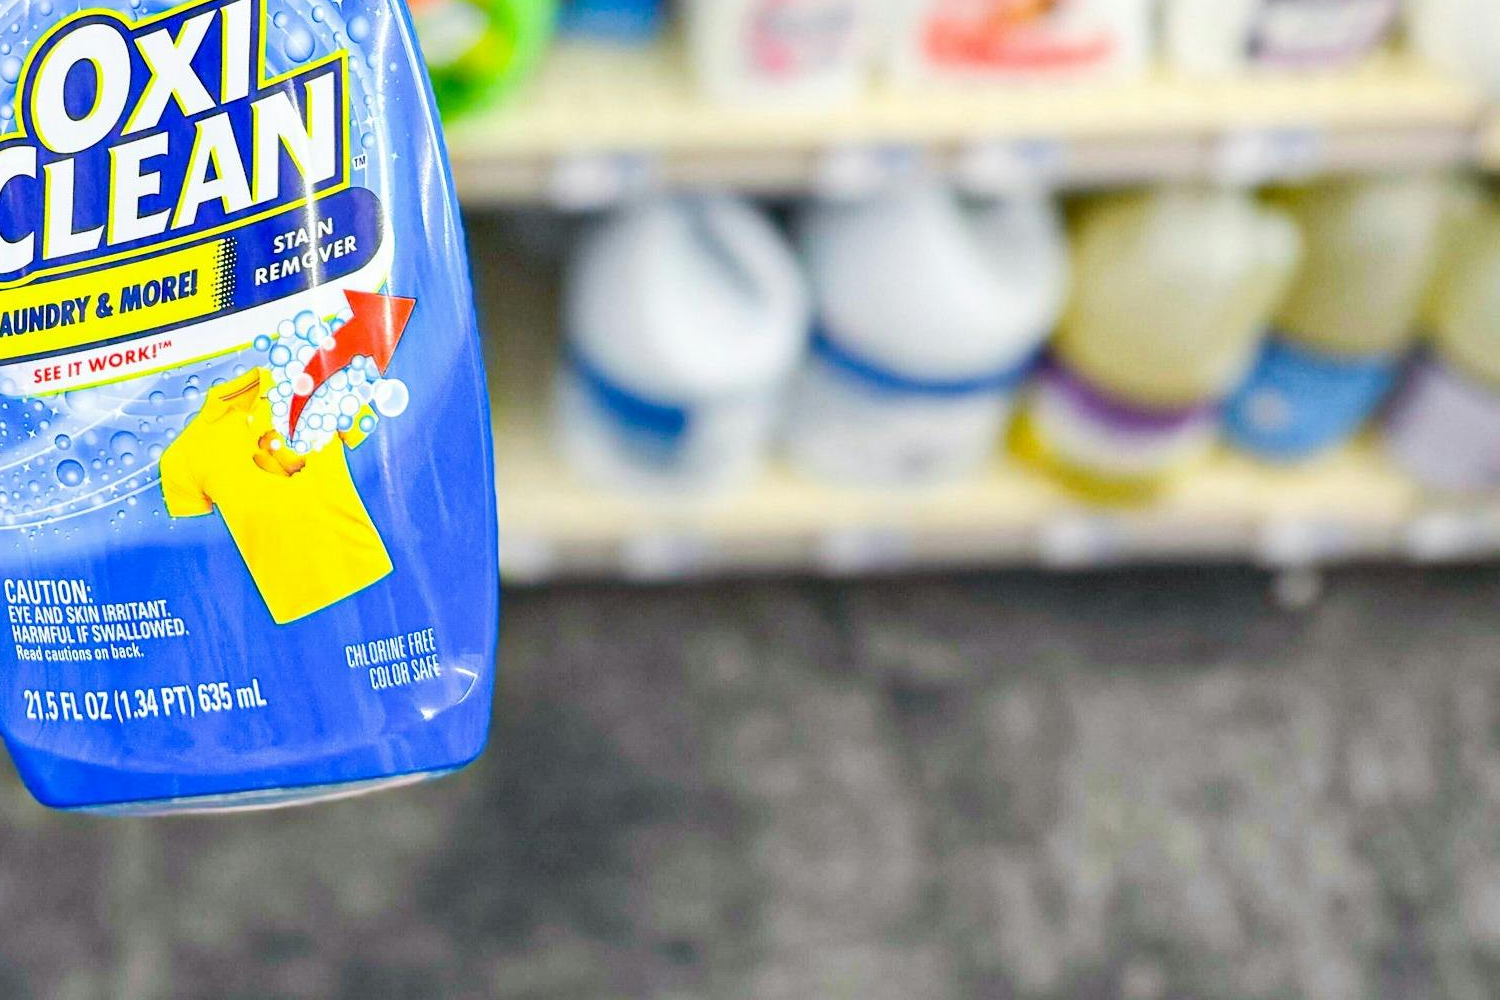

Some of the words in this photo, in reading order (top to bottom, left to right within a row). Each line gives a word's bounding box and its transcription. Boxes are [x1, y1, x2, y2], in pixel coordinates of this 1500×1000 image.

[273, 217, 334, 254] STAN
[254, 235, 357, 287] REMOVER
[95, 292, 113, 319] &
[119, 269, 199, 314] MORE!
[34, 365, 61, 384] SEE
[67, 361, 83, 378] IT
[4, 578, 94, 605] CAUTION:
[8, 605, 32, 624] EYE
[34, 606, 63, 625] AND
[65, 605, 100, 624] SKIN
[102, 599, 172, 623] IRRITANT.
[11, 624, 76, 644] HARMFUL
[77, 626, 90, 644] IF
[91, 618, 190, 643] SWALLOWED.
[345, 635, 407, 669] CHLORINE
[407, 628, 436, 657] FREE
[16, 645, 43, 662] Read
[45, 646, 92, 663] cautions
[94, 648, 109, 661] on
[110, 642, 145, 660] back.
[369, 661, 411, 690] COLOR
[411, 654, 441, 681] SAFE
[23, 689, 59, 721] 21.5
[60, 691, 83, 721] FL
[85, 691, 113, 721] OZ
[114, 689, 159, 724] (1.34
[160, 685, 196, 718] PT)
[197, 682, 233, 713] 635
[236, 679, 268, 708] mL
